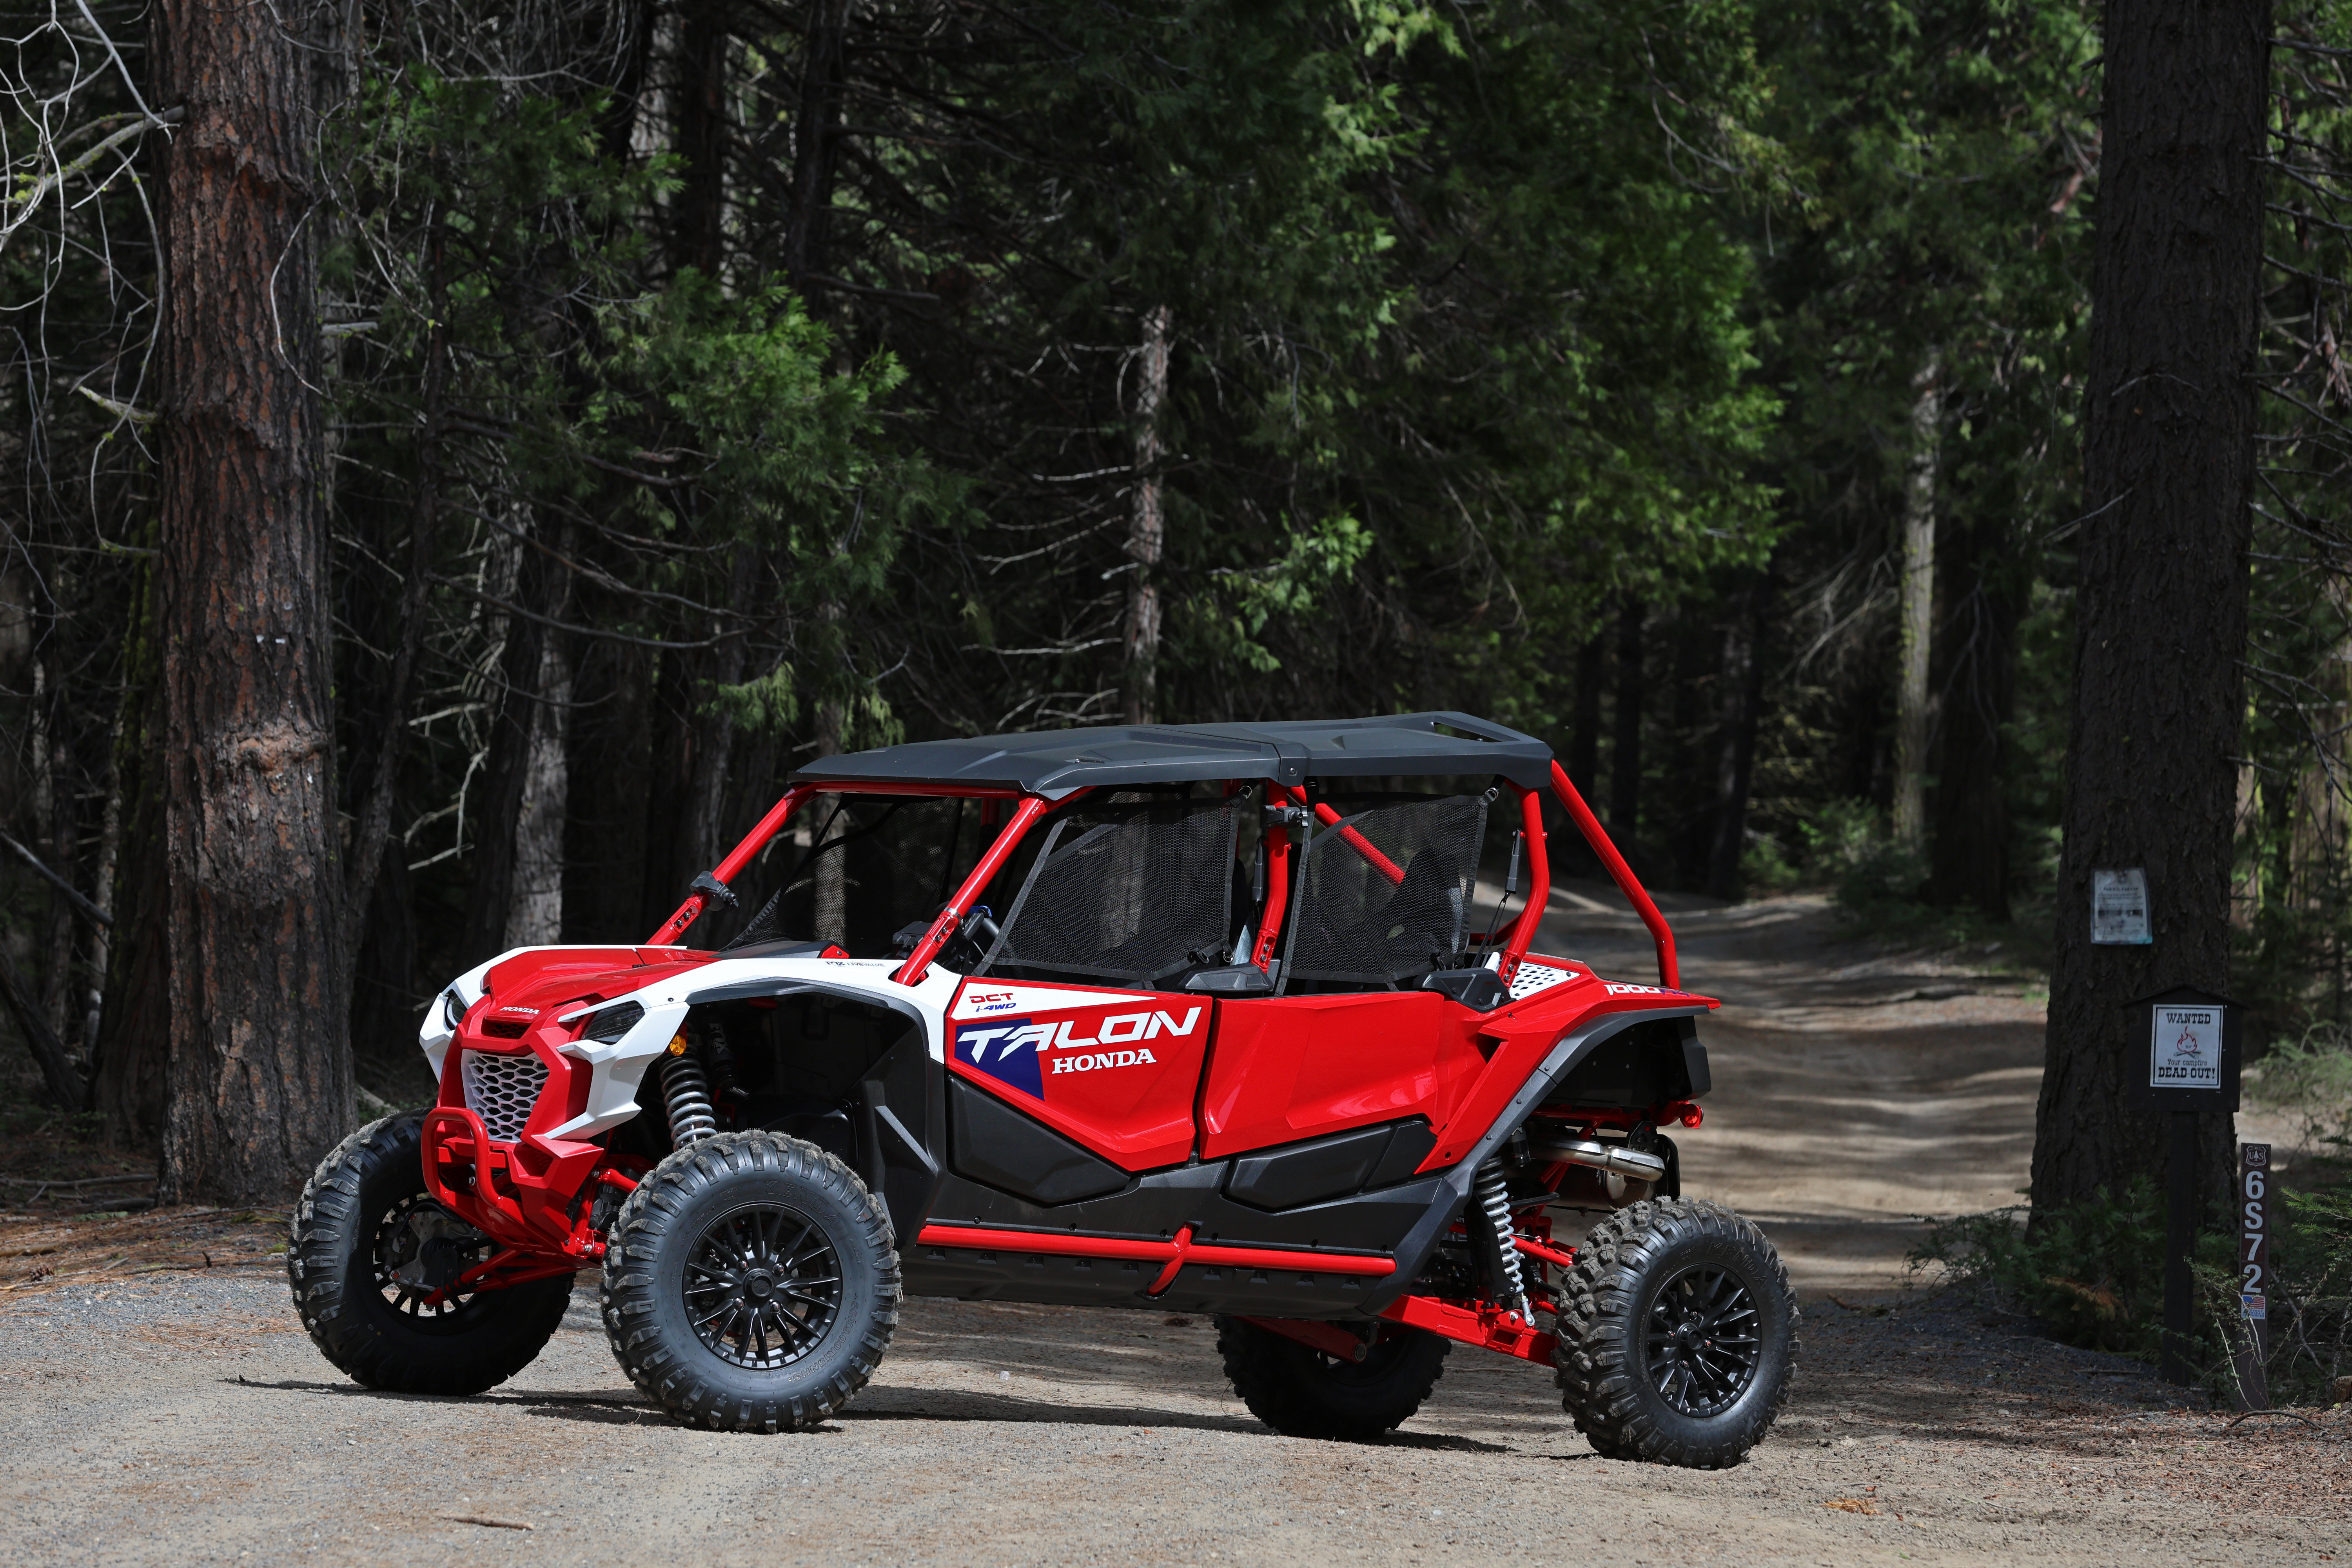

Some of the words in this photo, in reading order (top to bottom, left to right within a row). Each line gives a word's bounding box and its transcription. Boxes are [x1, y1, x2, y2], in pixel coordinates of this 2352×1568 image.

[969, 993, 1014, 1004] DCT
[975, 1002, 1016, 1013] i-4WD
[2166, 1013, 2211, 1024] WANTED
[957, 1007, 1202, 1063] TALON
[1052, 1049, 1157, 1074] HONDA
[2158, 1066, 2187, 1078] DEAD
[2190, 1067, 2216, 1079] OUT!
[758, 1180, 842, 1229] KENDA
[2243, 1171, 2264, 1293] 6S72
[1707, 1242, 1768, 1289] KENDA
